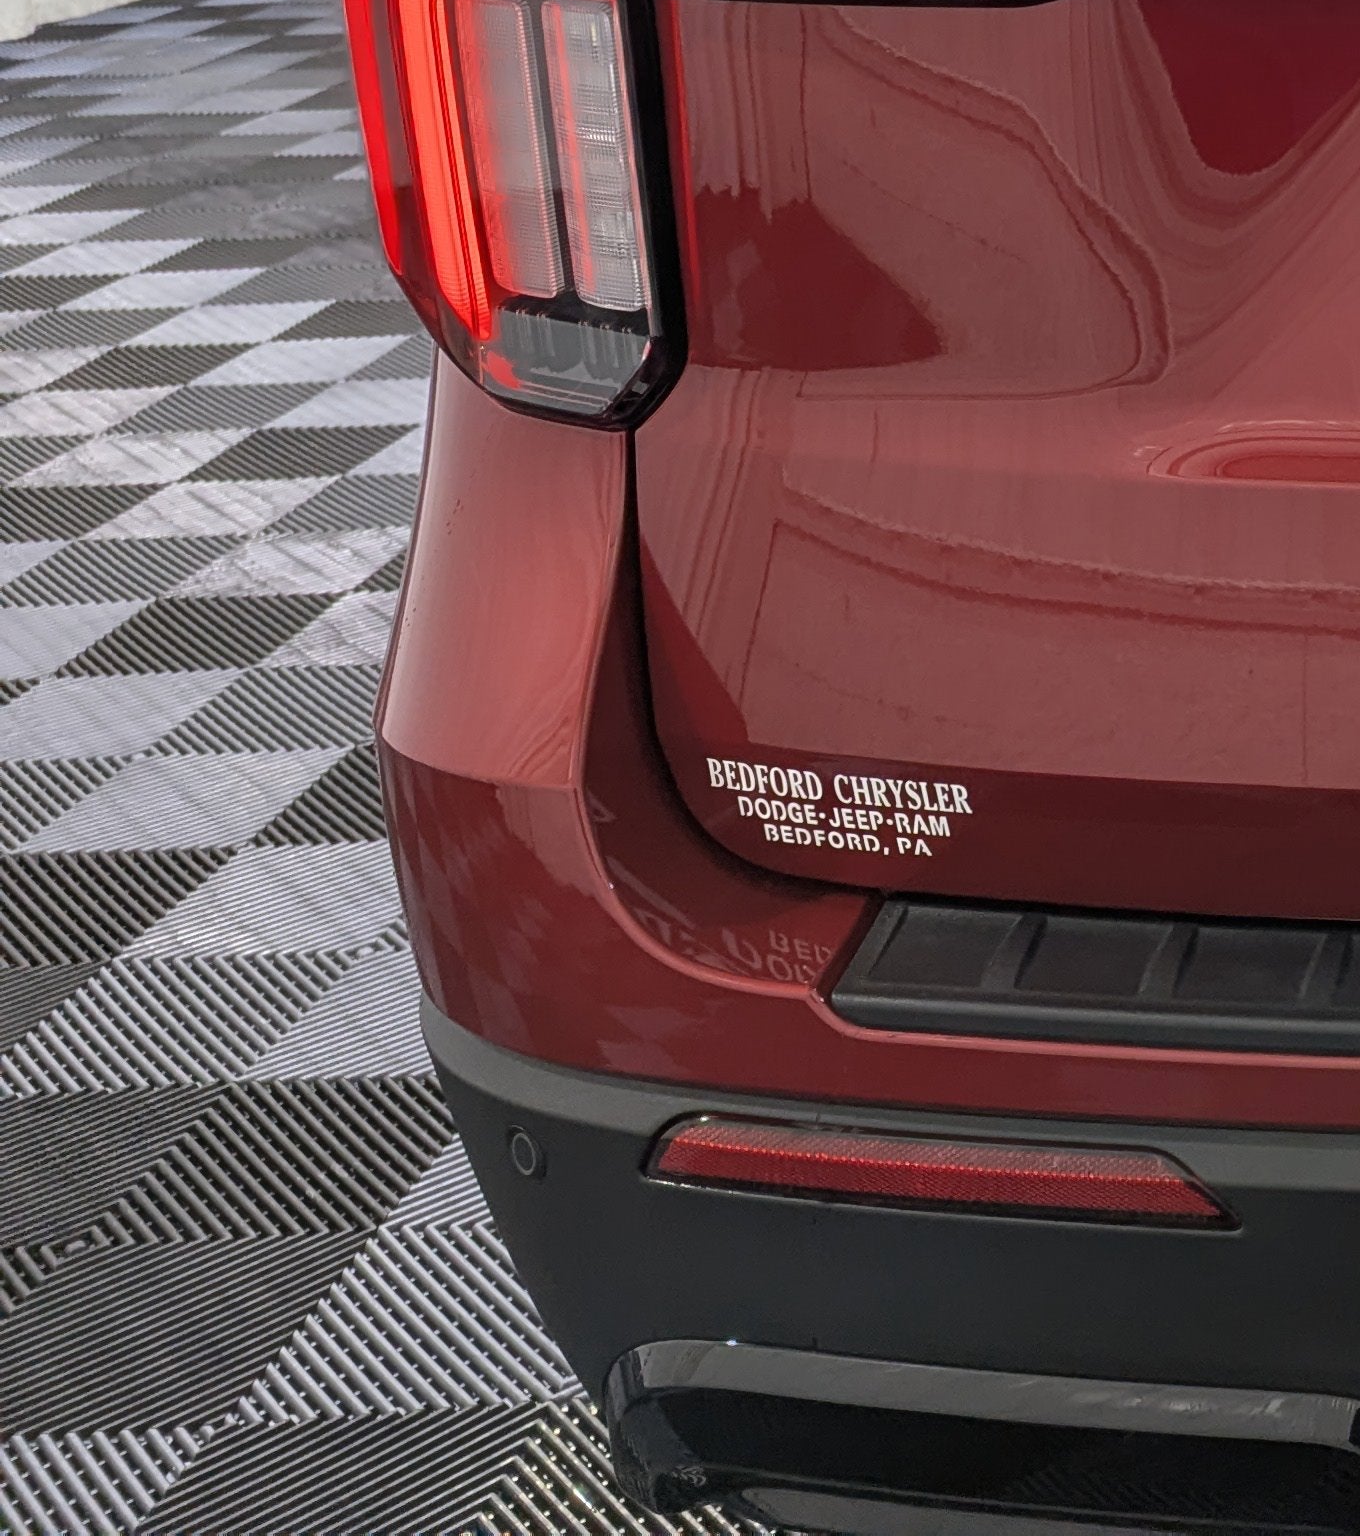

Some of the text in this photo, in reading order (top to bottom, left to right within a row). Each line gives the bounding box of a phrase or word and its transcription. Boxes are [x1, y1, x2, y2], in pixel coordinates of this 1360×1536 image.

[706, 757, 973, 815] BEDFORD CHRYSLER
[763, 823, 932, 857] BEDFORD, PA
